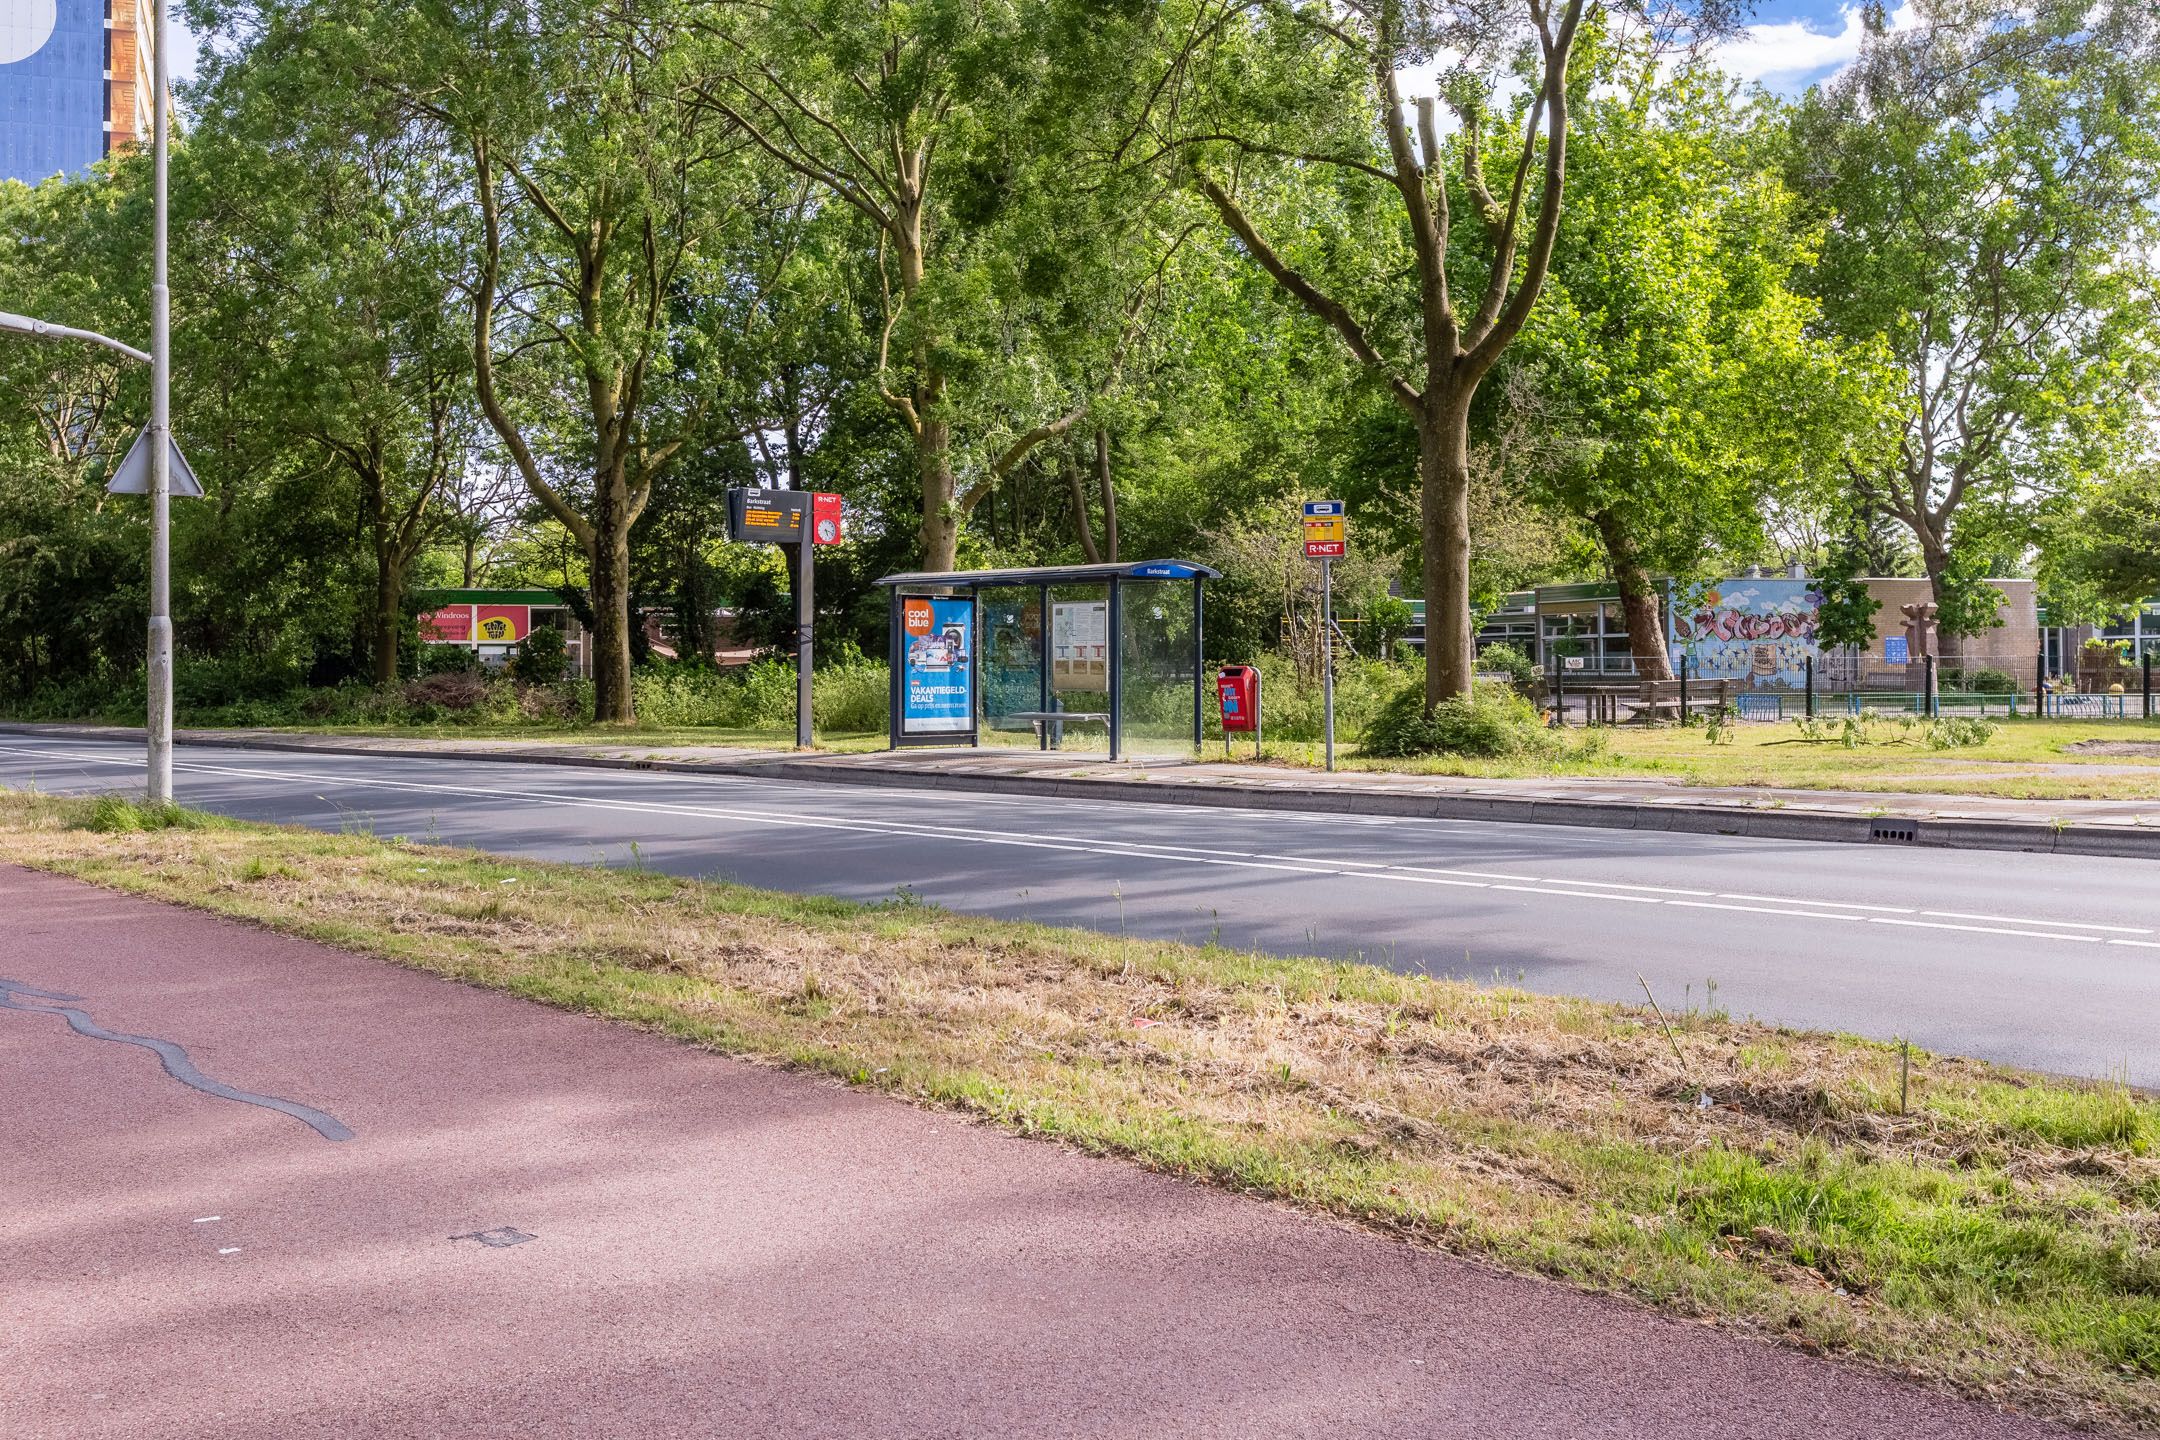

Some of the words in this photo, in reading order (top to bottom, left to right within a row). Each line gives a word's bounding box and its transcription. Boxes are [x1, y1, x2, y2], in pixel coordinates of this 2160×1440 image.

[908, 609, 929, 618] cool
[908, 617, 929, 627] blue
[911, 694, 934, 703] DEALS
